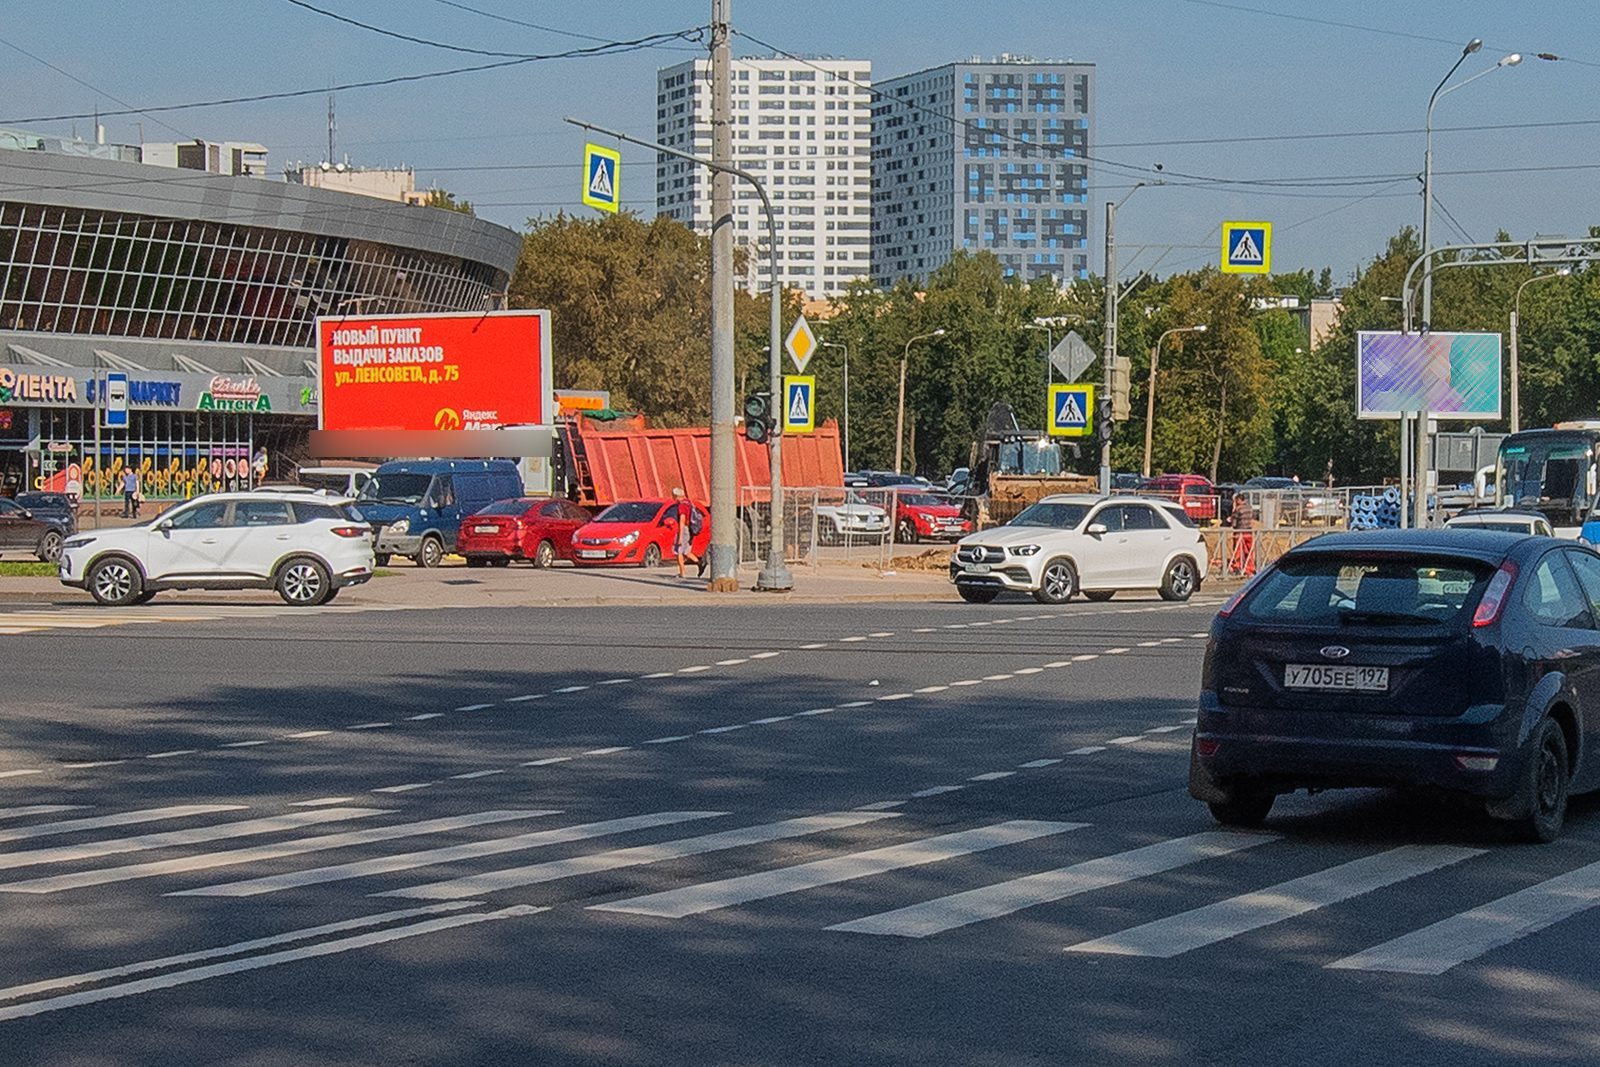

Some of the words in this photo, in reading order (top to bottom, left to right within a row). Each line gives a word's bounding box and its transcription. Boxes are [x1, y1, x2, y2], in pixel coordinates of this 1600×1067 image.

[333, 326, 379, 346] НОВЫЙ
[381, 328, 422, 345] ПУНКТ
[334, 348, 387, 367] ВЫДАЧИ
[388, 346, 444, 364] ЗАКАЗОВ
[335, 371, 354, 387] ул.
[355, 366, 427, 384] ЛЕНСОВЕТА,
[429, 369, 443, 384] д.
[443, 364, 459, 381] 75
[462, 410, 498, 421] Яндекс
[1292, 667, 1355, 687] У705ЕЕ
[1359, 668, 1385, 683] 197
